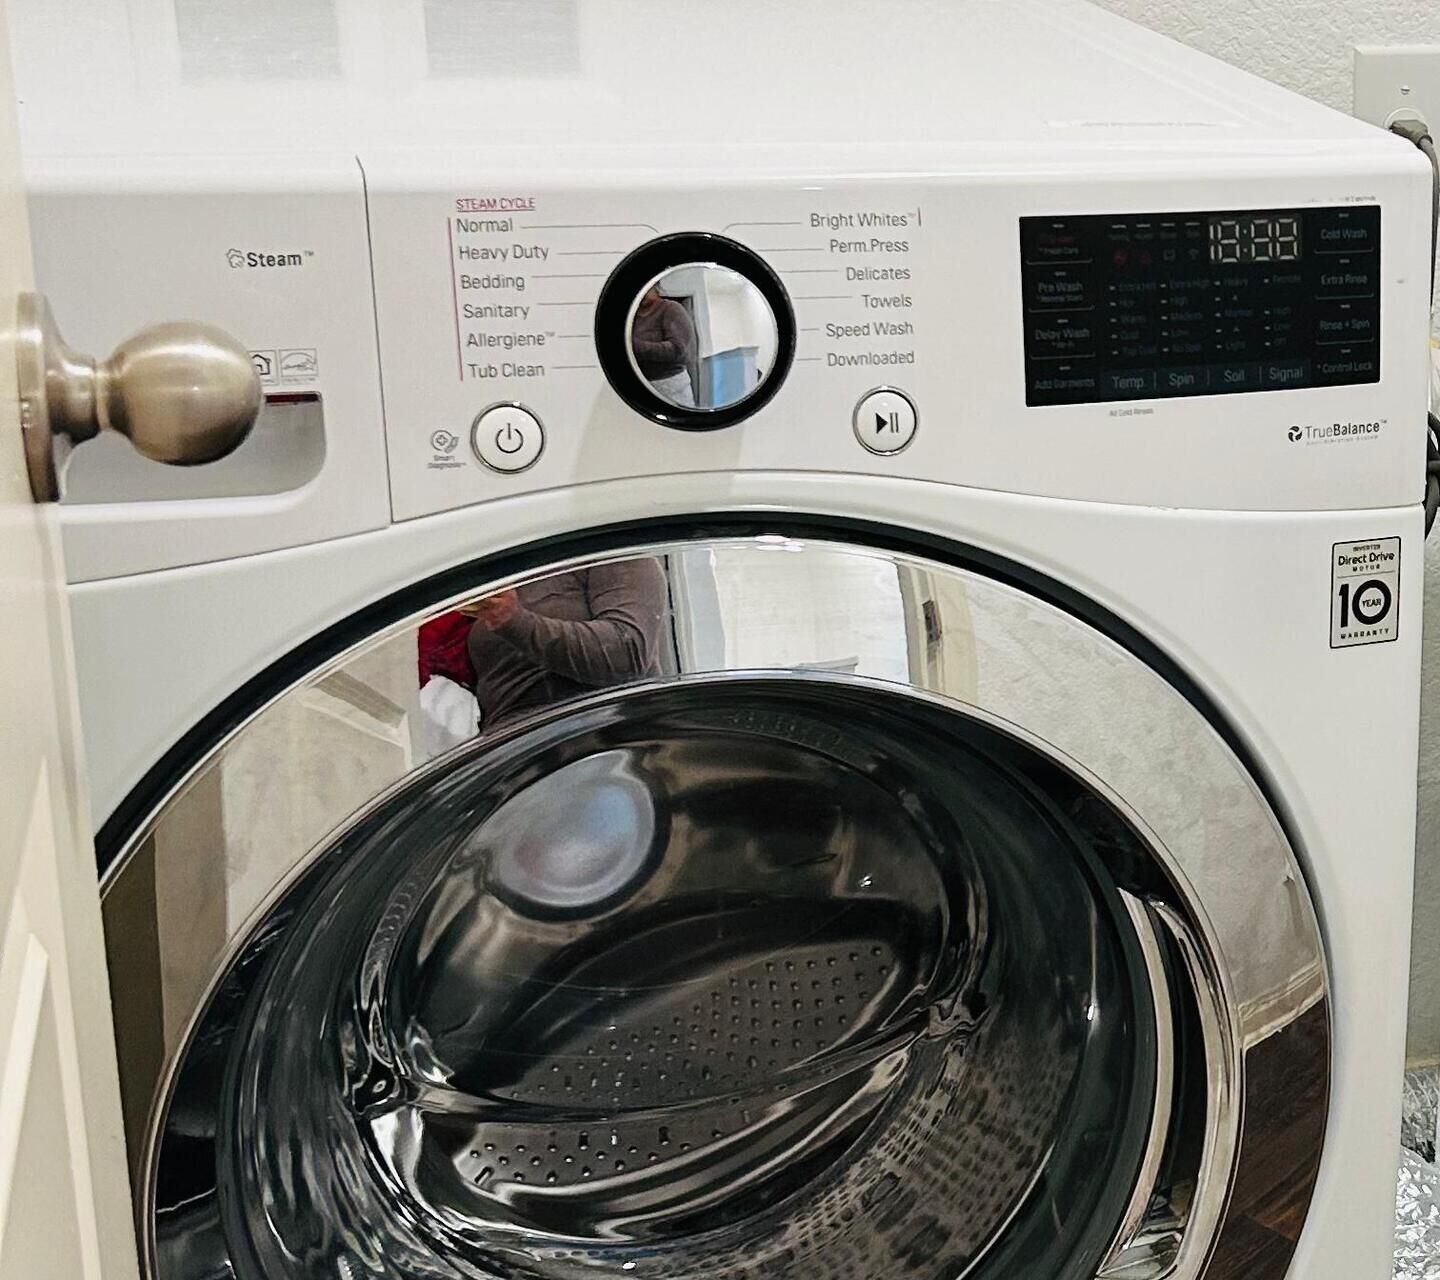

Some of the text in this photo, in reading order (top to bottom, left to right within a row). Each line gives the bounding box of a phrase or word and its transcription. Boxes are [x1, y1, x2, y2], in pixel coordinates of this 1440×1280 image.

[456, 197, 536, 210] STEAM CYCLE
[456, 218, 513, 233] Normal
[810, 212, 854, 230] Bright
[1342, 227, 1368, 239] Wash
[459, 244, 550, 262] Heavy Duty
[846, 267, 911, 281] Delicates
[1321, 275, 1344, 286] Extra
[461, 274, 525, 291] Bedding
[861, 294, 913, 308] Towels
[463, 303, 530, 320] Sanitary
[826, 322, 914, 339] Speed Wash
[827, 351, 915, 367] Downloaded
[467, 363, 545, 379] Tub Clean
[1224, 369, 1245, 382] Soil
[1269, 366, 1303, 382] Signal
[1112, 375, 1145, 390] Temp
[1168, 373, 1194, 388] Spin
[1338, 551, 1395, 566] Direct Drive
[1352, 564, 1381, 572] MOTOR
[1338, 579, 1392, 628] 10
[1361, 598, 1382, 608] YEAR
[1340, 628, 1389, 639] WARRANTY
